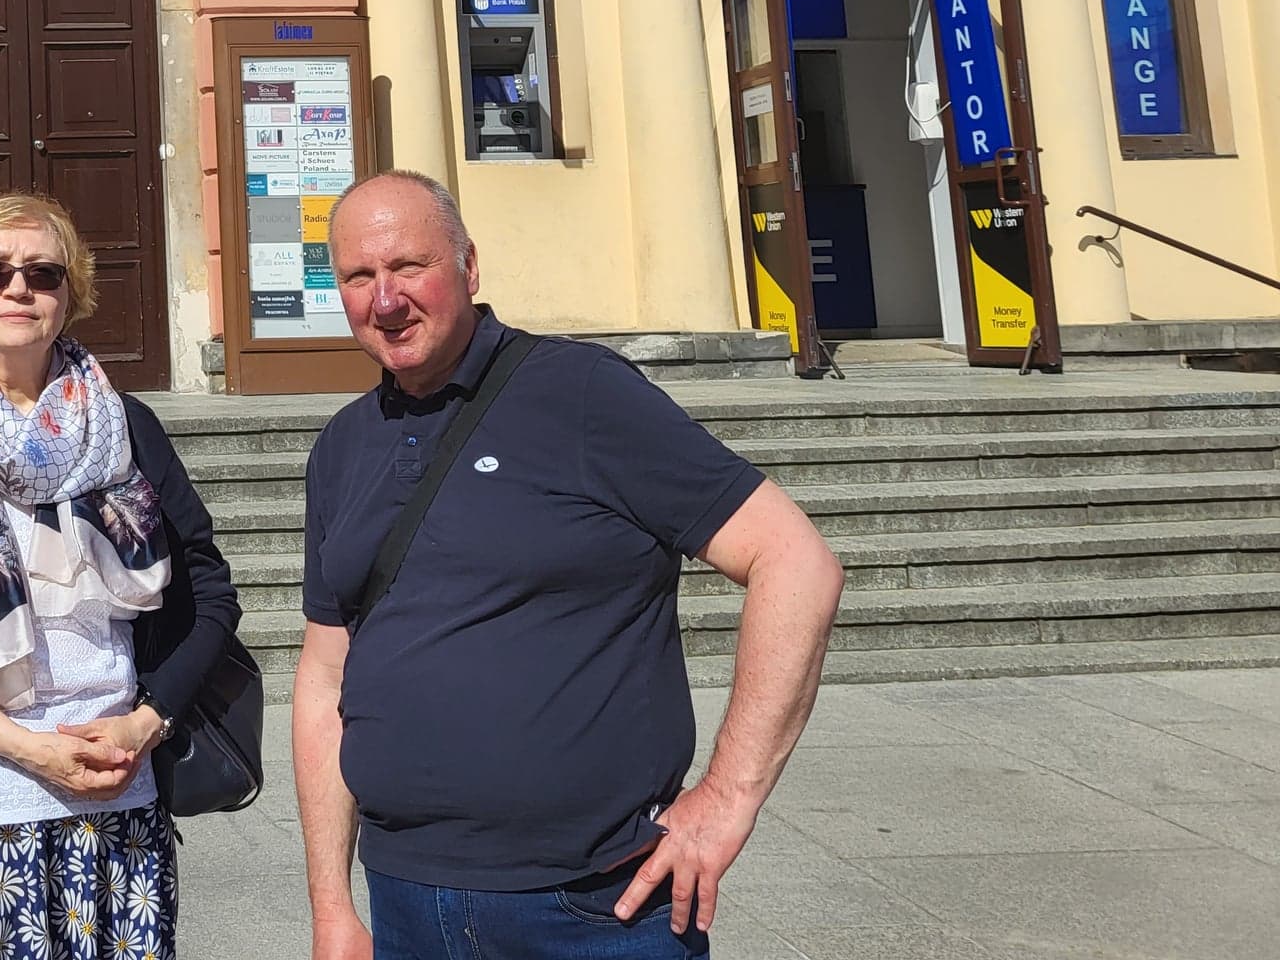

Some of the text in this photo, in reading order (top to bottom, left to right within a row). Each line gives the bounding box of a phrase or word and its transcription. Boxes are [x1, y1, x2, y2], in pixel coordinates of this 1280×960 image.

[304, 214, 328, 223] Radio
[769, 311, 787, 322] Money
[993, 306, 1022, 318] Money
[992, 318, 1027, 329] Transfer
